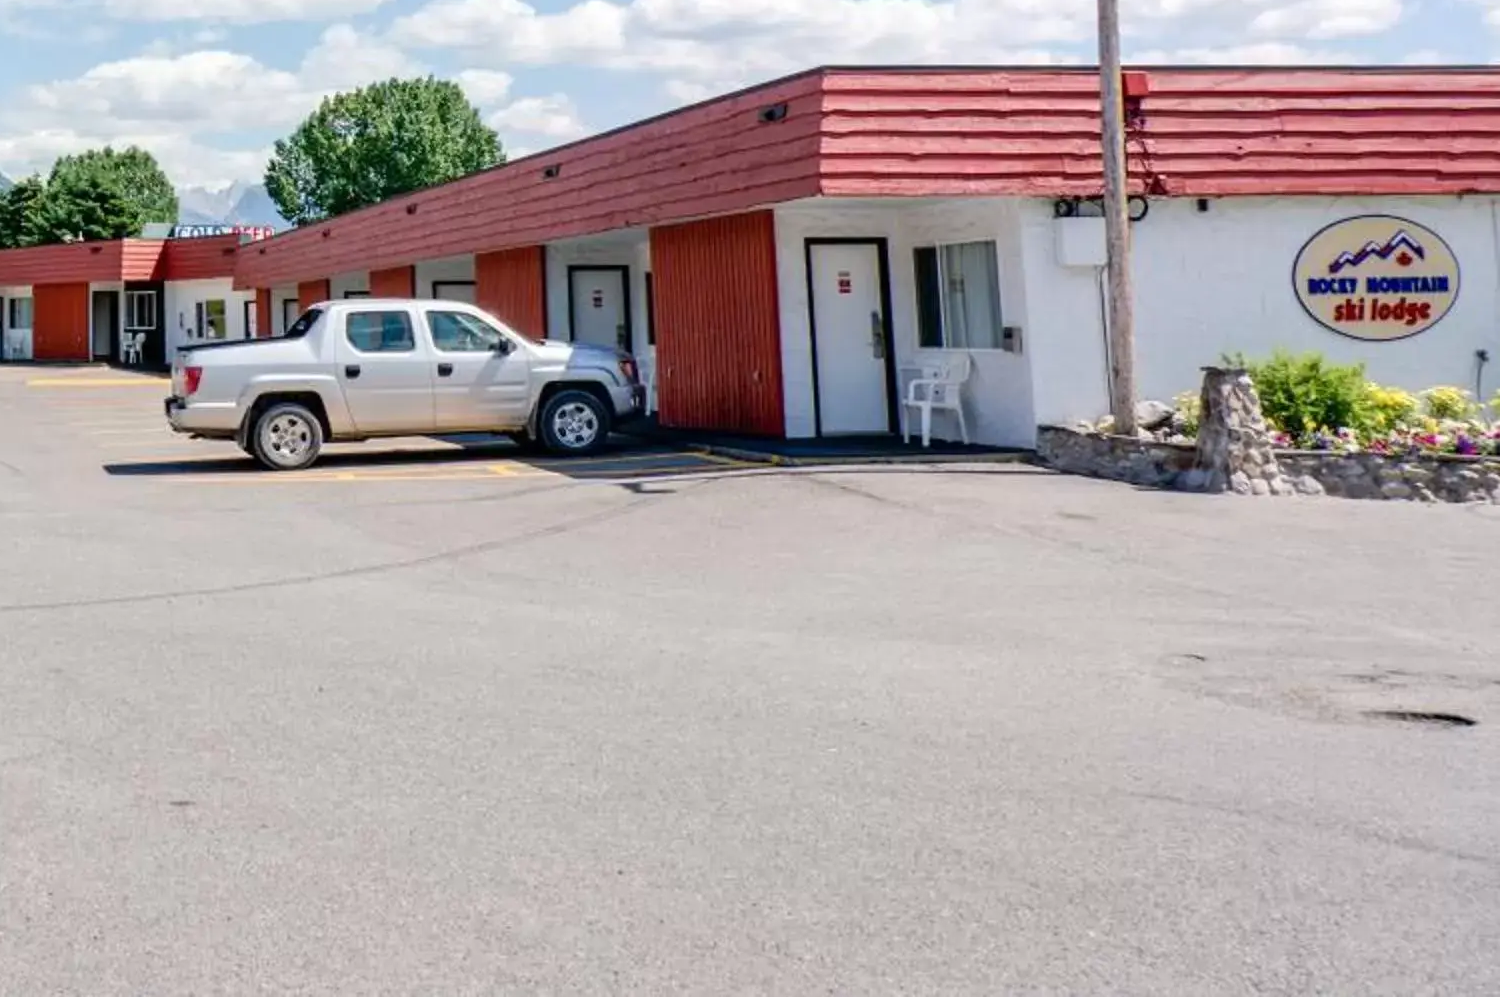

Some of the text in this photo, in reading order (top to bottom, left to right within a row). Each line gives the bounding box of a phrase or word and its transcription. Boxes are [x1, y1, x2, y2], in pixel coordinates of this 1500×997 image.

[1308, 276, 1449, 294] ROCKY MOUNTAIN
[1334, 297, 1431, 326] ski lodge
